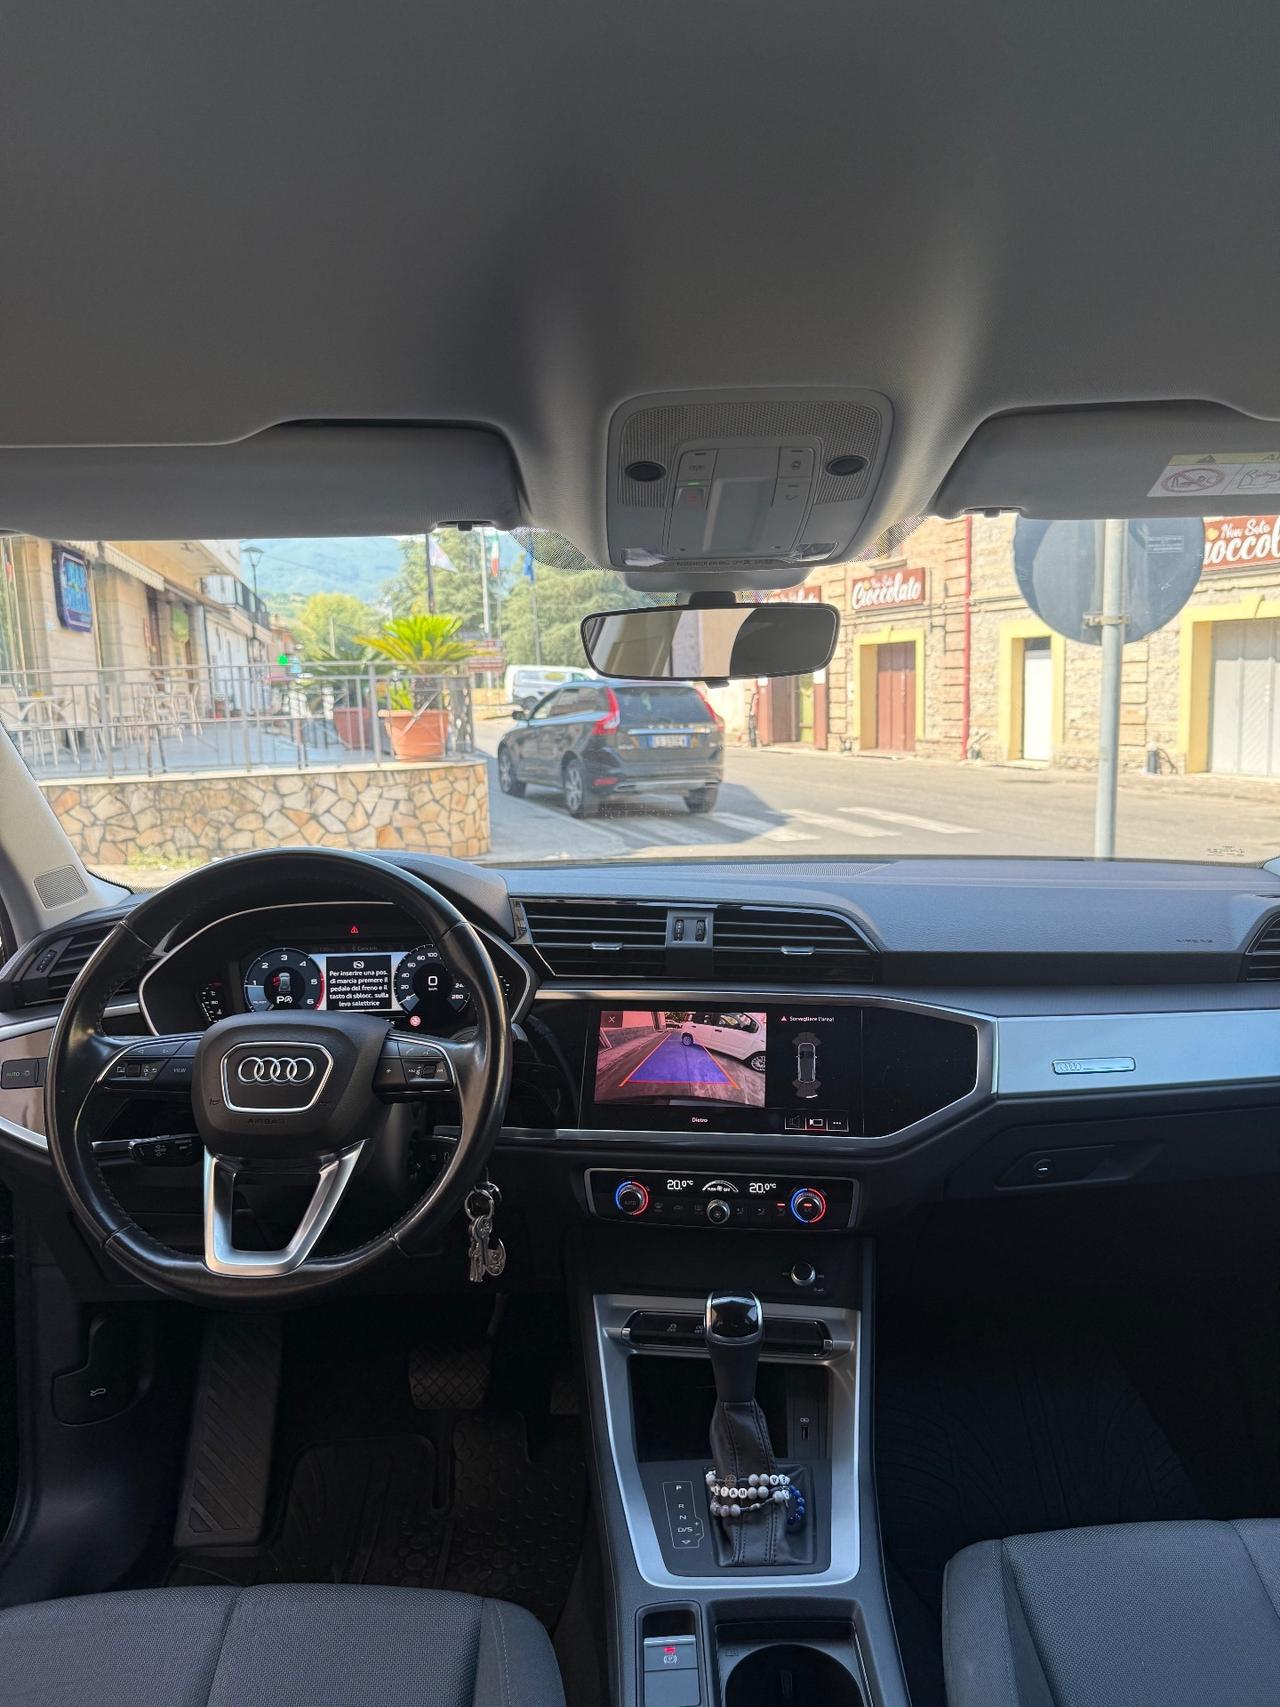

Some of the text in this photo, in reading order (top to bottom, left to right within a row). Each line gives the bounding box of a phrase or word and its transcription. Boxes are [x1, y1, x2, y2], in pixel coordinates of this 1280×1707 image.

[1220, 518, 1271, 538] Non Solo
[852, 572, 921, 610] Cioccolato
[427, 975, 438, 986] 0
